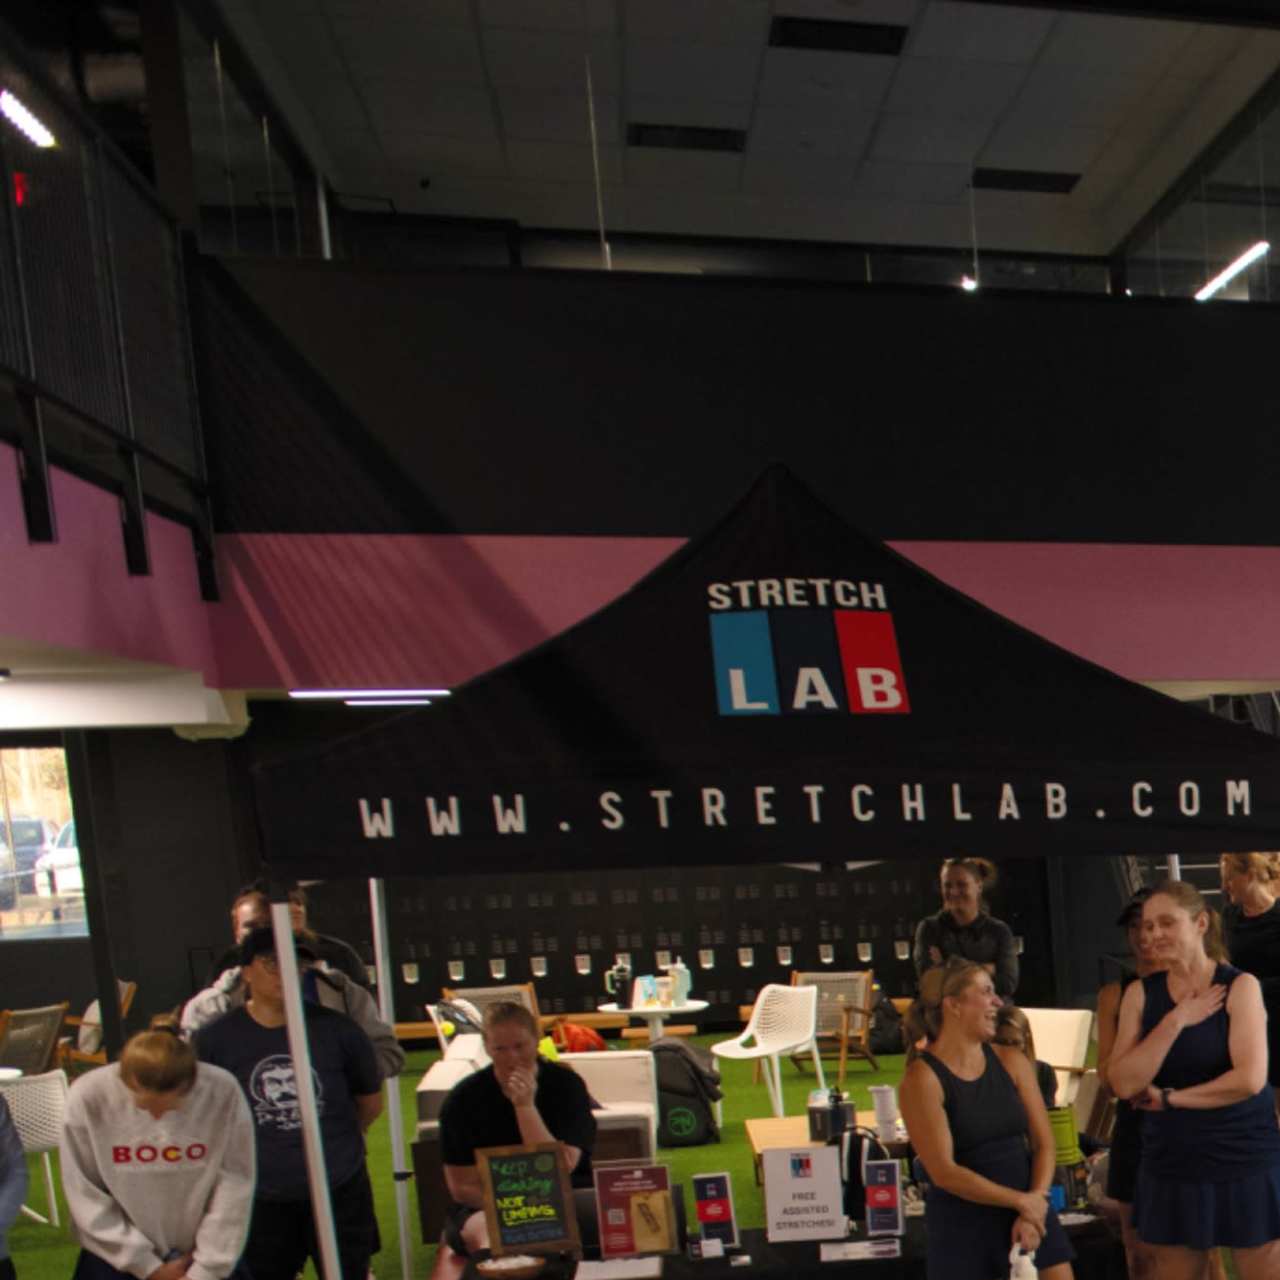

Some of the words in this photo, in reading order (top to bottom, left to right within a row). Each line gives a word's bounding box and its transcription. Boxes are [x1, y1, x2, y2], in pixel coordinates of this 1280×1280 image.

[707, 577, 888, 610] STRETCH
[728, 667, 903, 711] LAB
[358, 779, 1254, 840] WWW.STRETCHLAB.COM
[782, 1205, 829, 1216] ASSISTED
[791, 1191, 817, 1202] FREE
